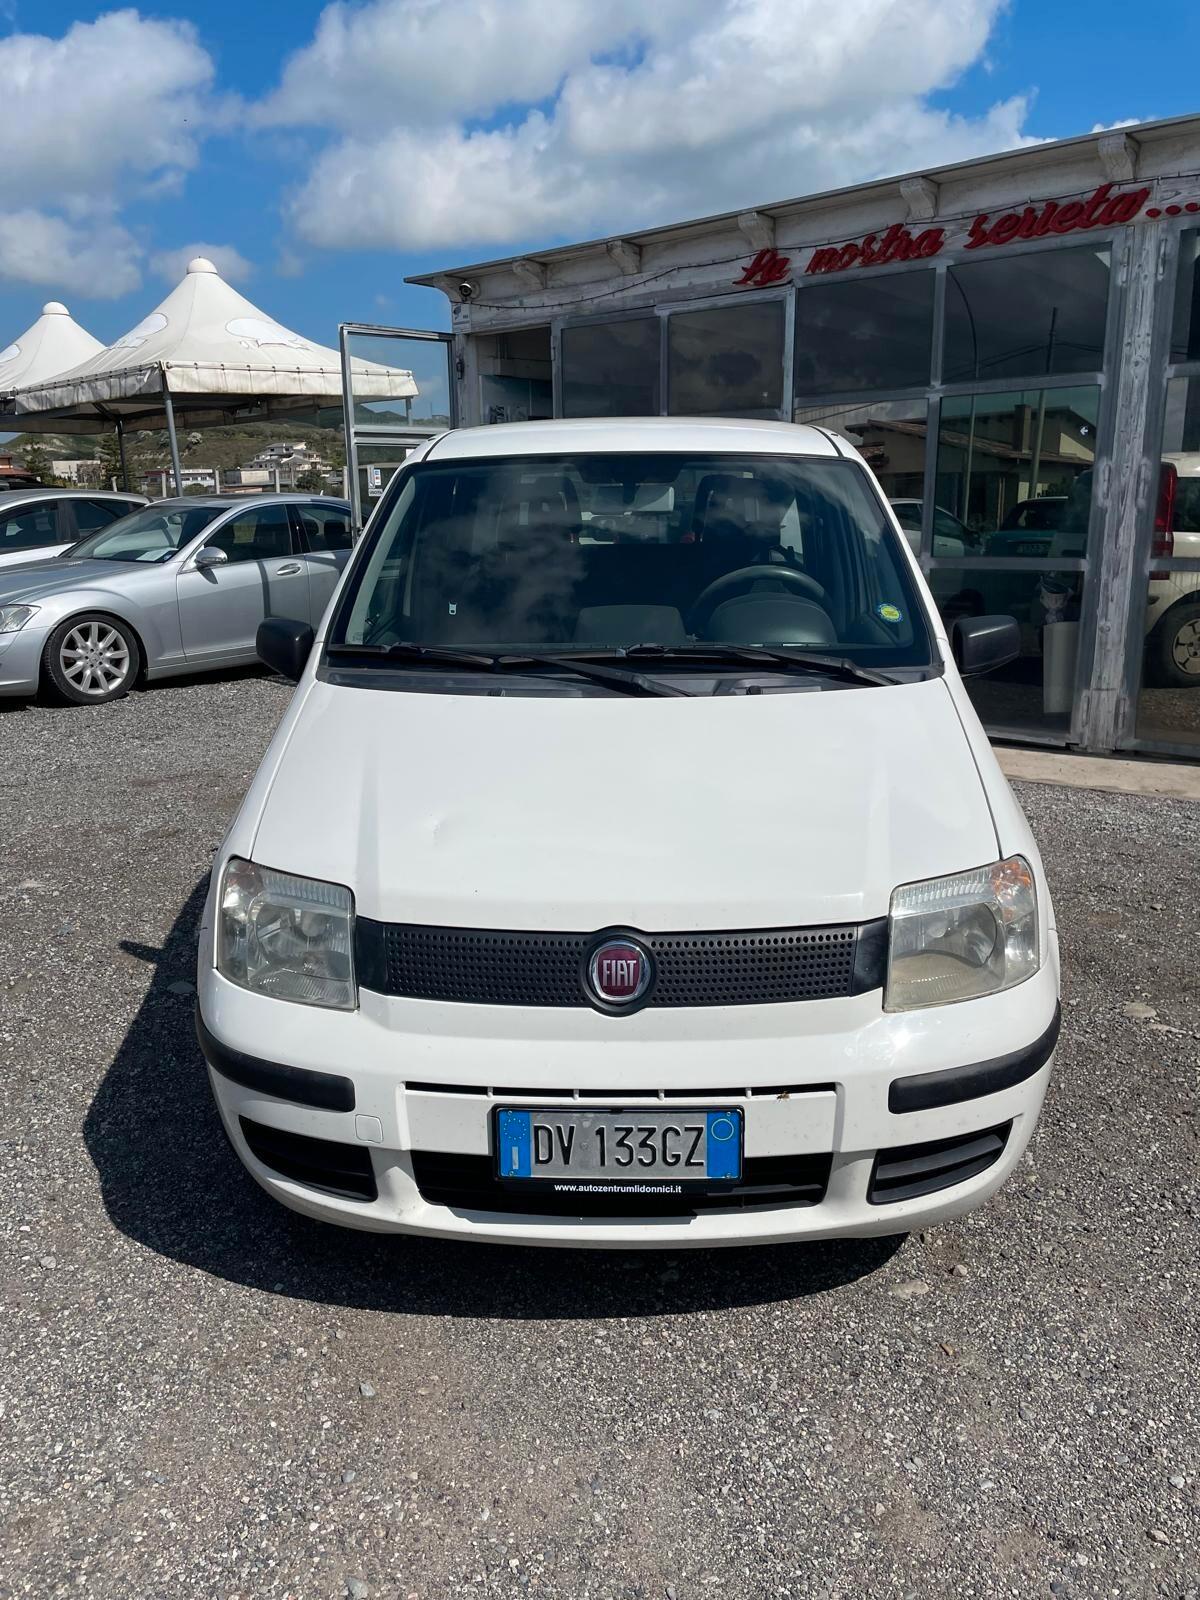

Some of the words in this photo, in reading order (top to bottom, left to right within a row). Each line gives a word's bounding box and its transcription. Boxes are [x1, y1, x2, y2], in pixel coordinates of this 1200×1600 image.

[805, 223, 945, 274] mostra
[602, 959, 637, 987] FIAT
[533, 1125, 575, 1166] DV
[595, 1125, 705, 1168] 133GZ
[554, 1184, 682, 1194] www.autozentrumlidonnici.it
